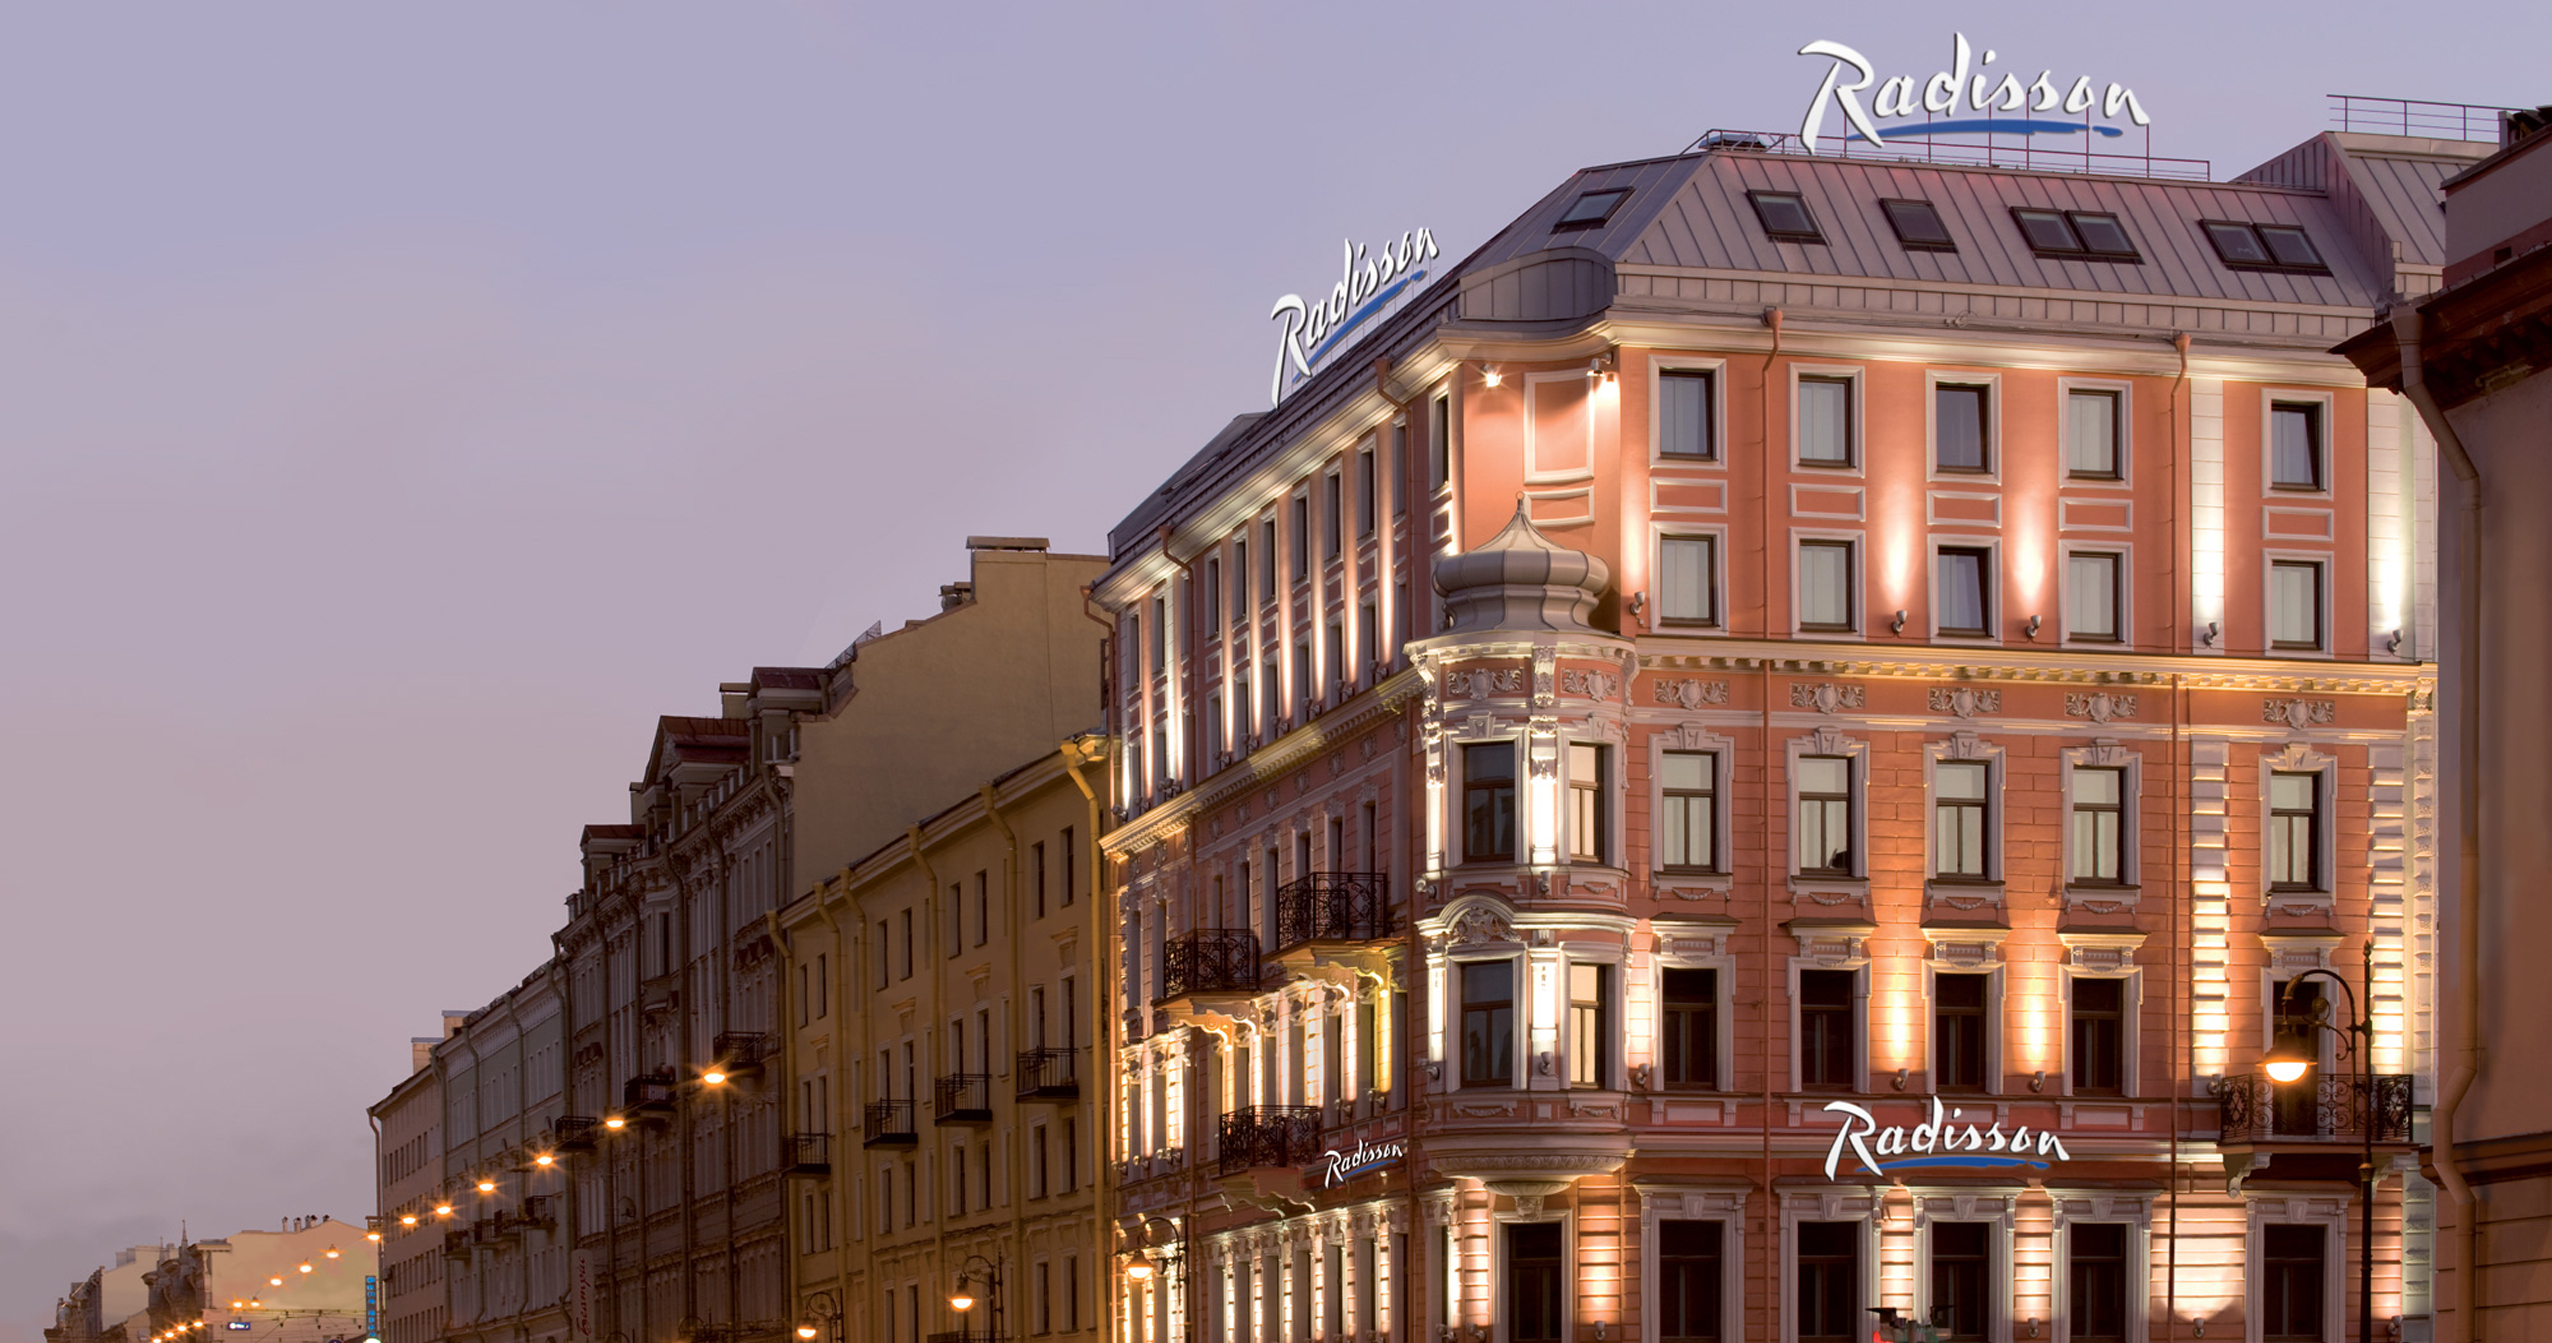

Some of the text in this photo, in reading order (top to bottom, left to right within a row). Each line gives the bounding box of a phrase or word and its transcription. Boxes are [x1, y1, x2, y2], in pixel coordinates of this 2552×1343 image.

[1797, 32, 2150, 154] Radisson
[1270, 227, 1439, 410] Radisson
[1324, 1139, 1403, 1189] Radisson
[1823, 1095, 2070, 1182] Radisson
